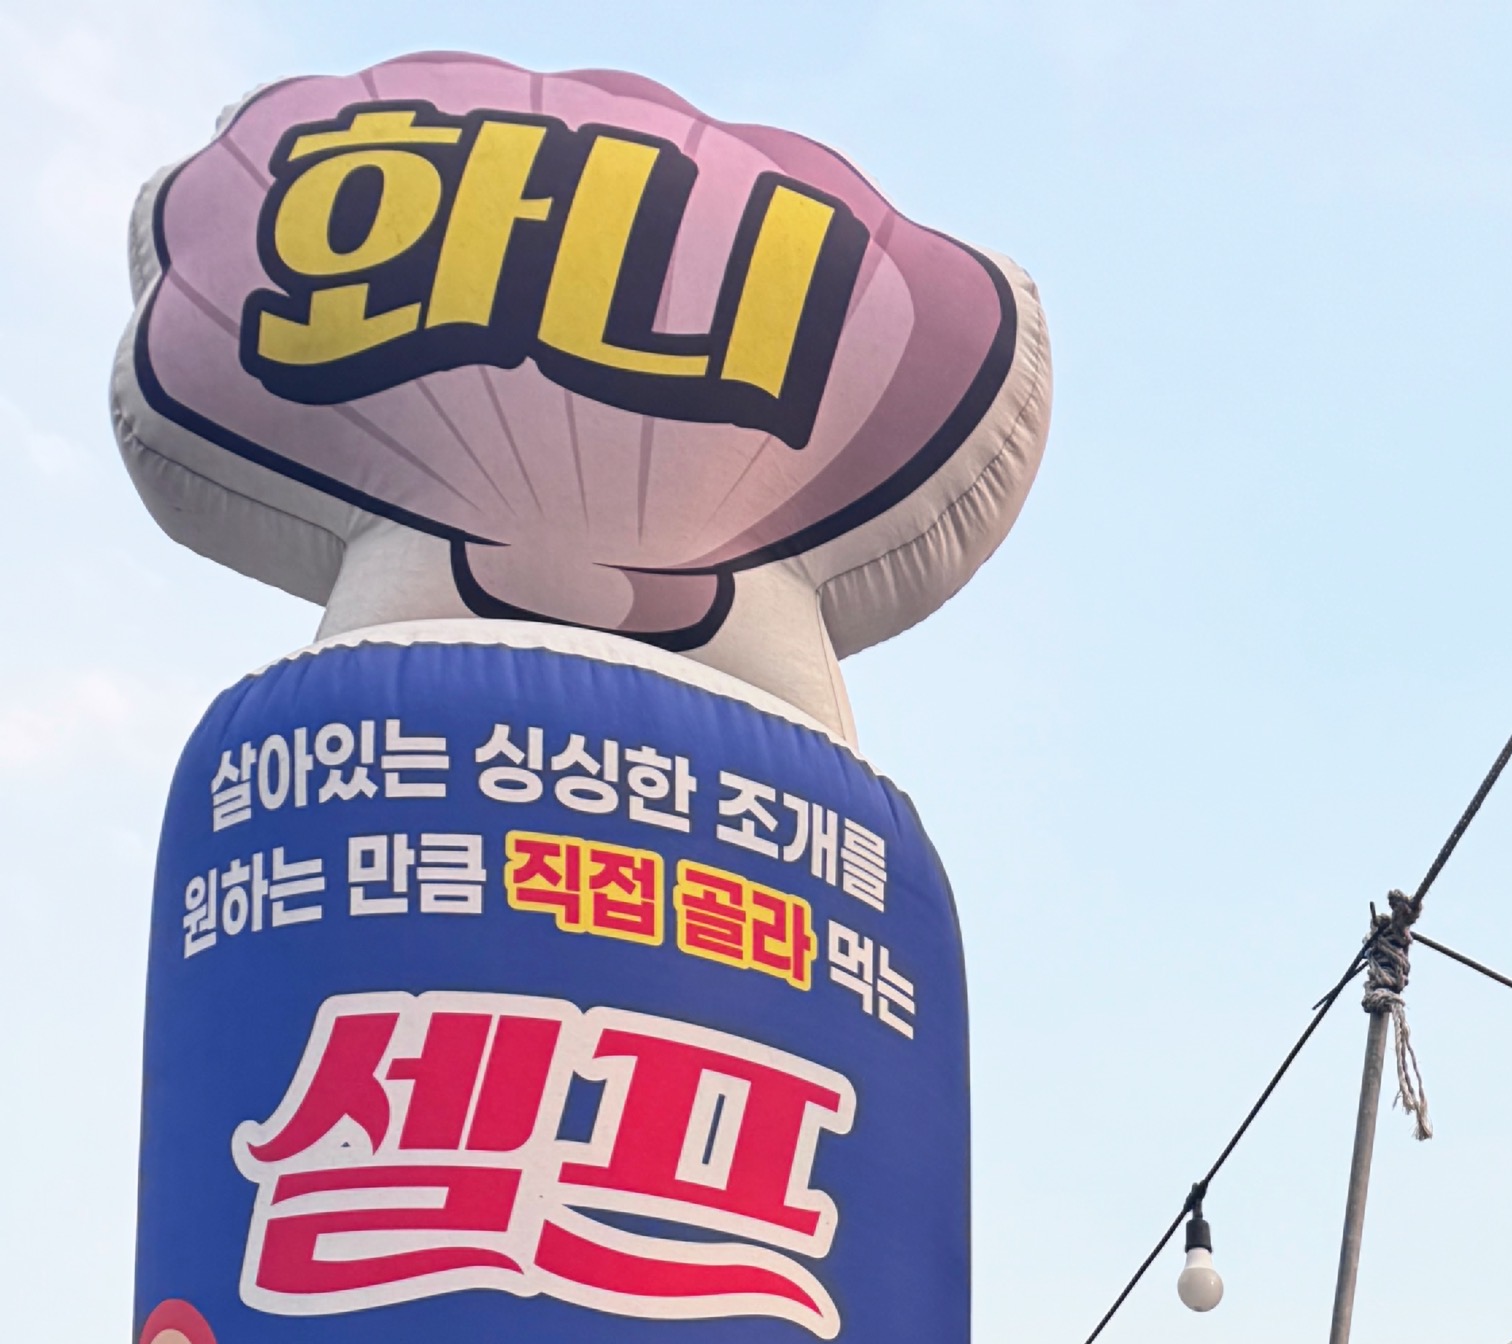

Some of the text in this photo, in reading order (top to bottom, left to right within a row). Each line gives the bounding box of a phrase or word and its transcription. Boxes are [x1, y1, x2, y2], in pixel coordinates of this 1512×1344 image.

[254, 106, 840, 402] 화니
[182, 831, 917, 1040] 원하는 만큼 직접 골라 먹는
[210, 717, 888, 913] 살아있는 싱싱한 조개를
[240, 1000, 850, 1331] 셀프
